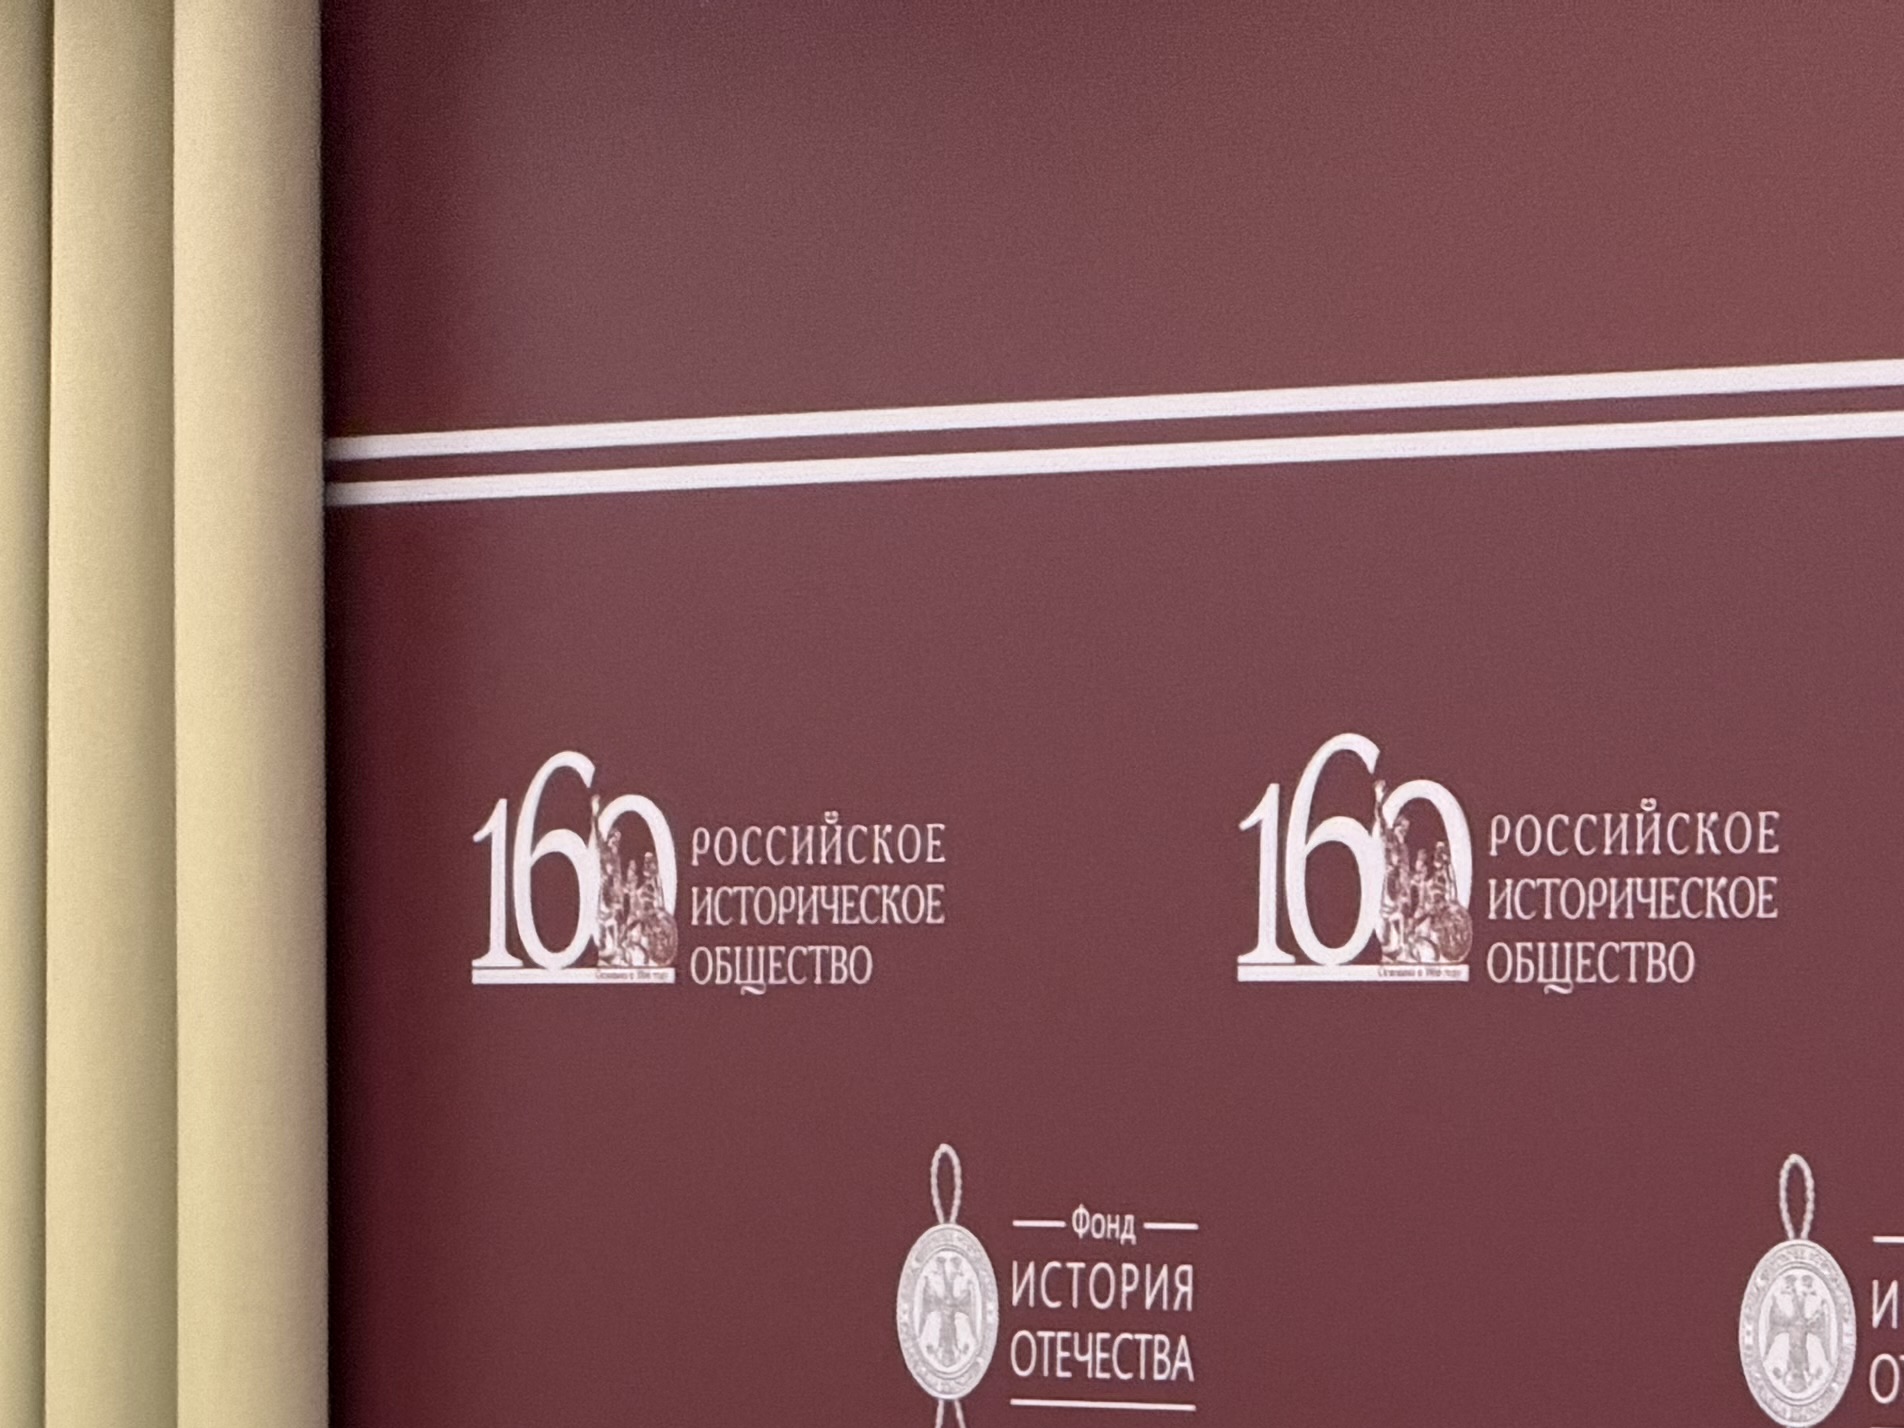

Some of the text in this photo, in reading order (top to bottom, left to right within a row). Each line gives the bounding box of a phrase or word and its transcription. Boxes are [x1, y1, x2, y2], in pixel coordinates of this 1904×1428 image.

[690, 810, 947, 868] РОССИЙСКОЕ
[1488, 797, 1781, 857] РОССИЙСКОЕ
[690, 883, 946, 926] ИСТОРИЧЕСКОЕ
[1487, 875, 1779, 921] ИСТОРИЧЕСКОЕ
[689, 944, 874, 996] ОБЩЕСТВО
[1486, 940, 1696, 995] ОБЩЕСТВО
[1071, 1203, 1137, 1245] Фонд
[1011, 1260, 1194, 1311] ИСТОРИЯ
[1010, 1329, 1195, 1382] ОТЕЧЕСТВА
